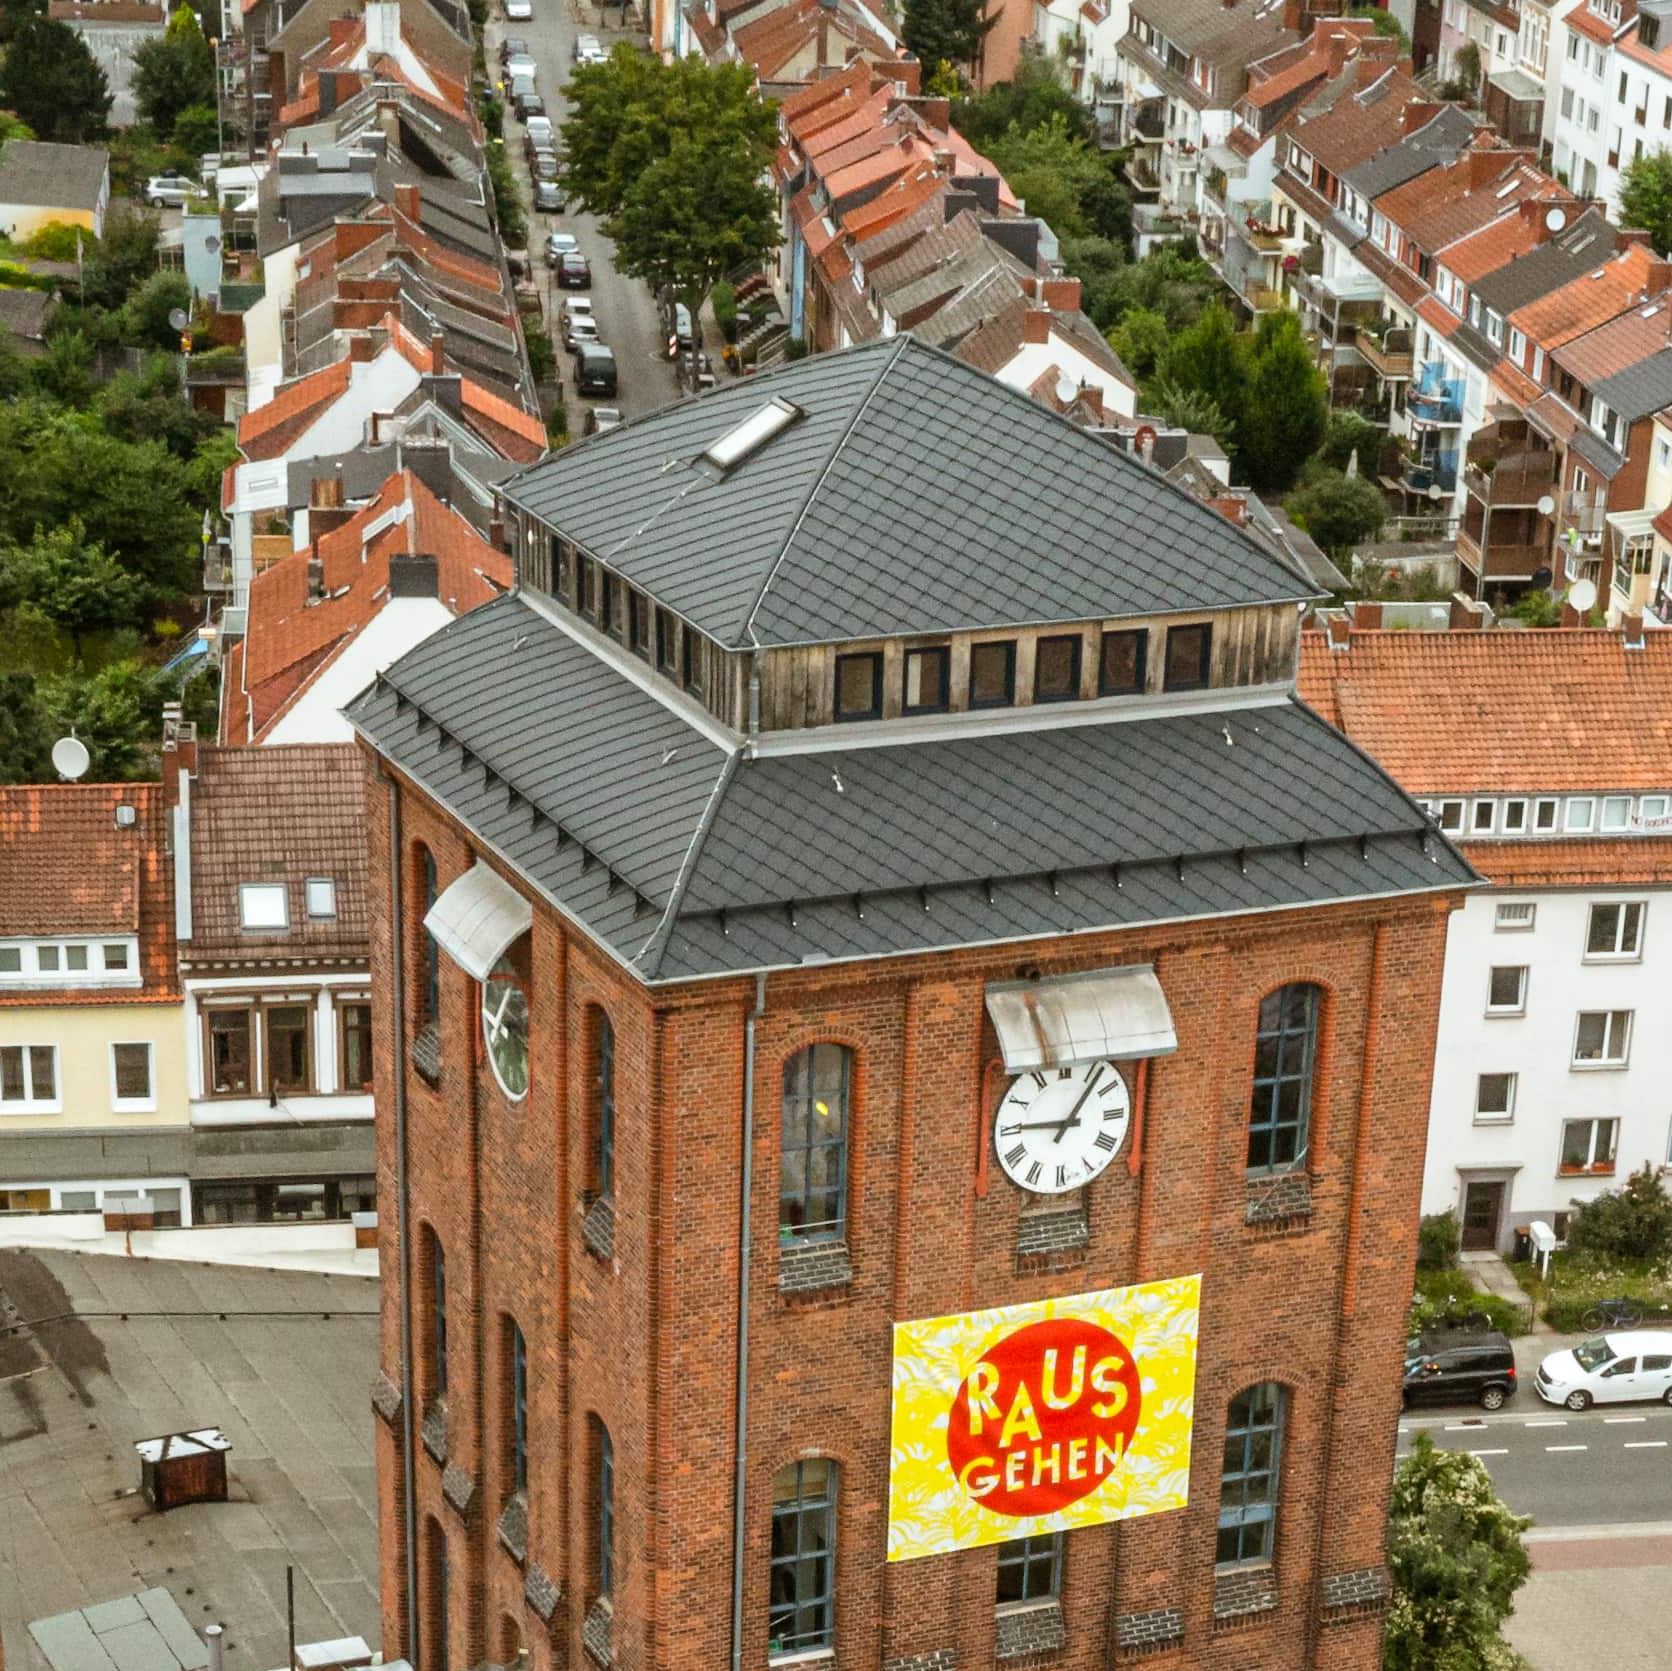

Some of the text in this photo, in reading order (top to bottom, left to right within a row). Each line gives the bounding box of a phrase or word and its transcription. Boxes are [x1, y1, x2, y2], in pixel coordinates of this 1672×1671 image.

[1097, 1079, 1119, 1099] II
[1103, 1107, 1124, 1121] III
[1025, 1159, 1044, 1186] VII
[967, 1345, 1129, 1449] RAUS
[959, 1432, 1125, 1498] GEHEN
